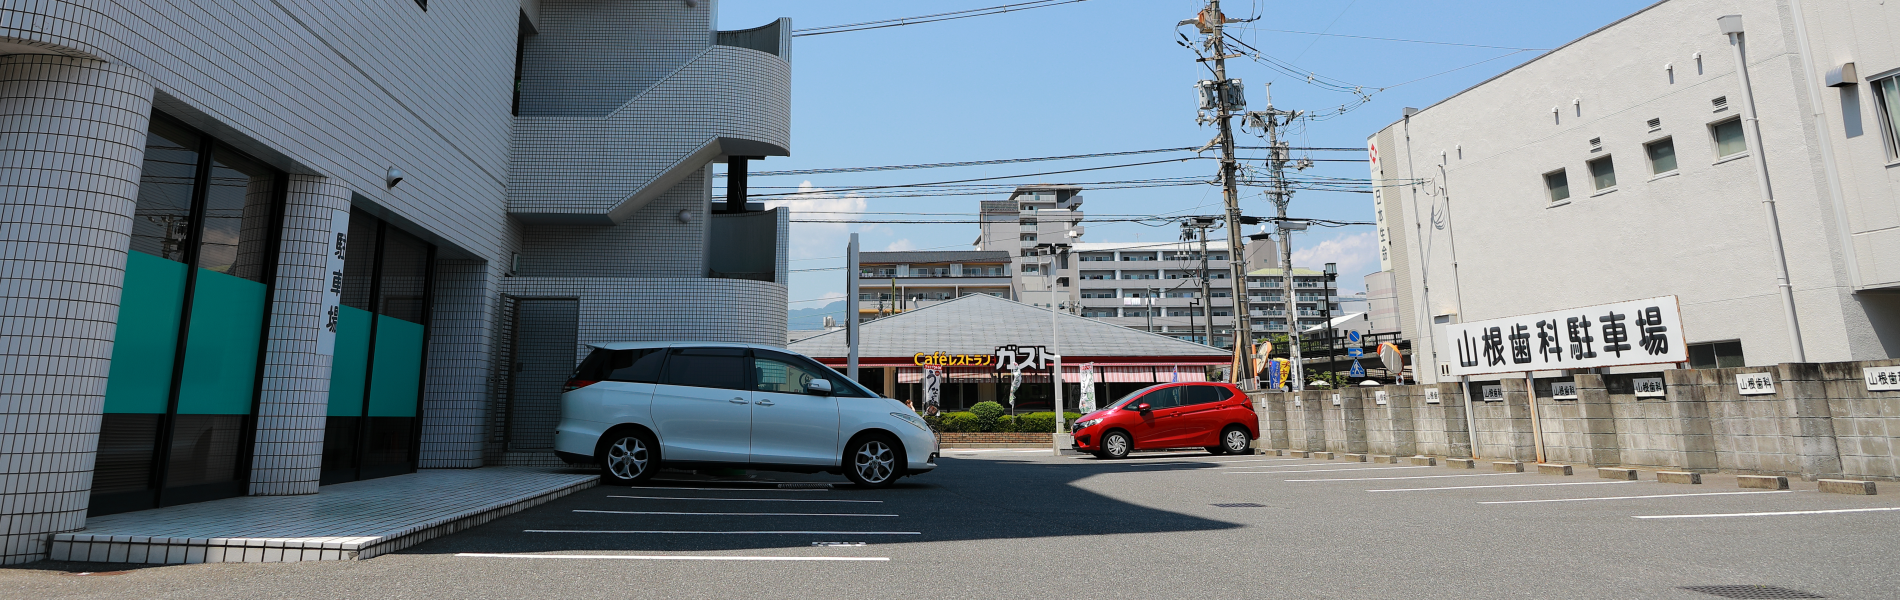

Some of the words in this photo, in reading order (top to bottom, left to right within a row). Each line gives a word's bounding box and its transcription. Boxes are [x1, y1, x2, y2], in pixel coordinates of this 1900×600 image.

[326, 232, 347, 334] 駐車場
[1457, 306, 1669, 368] 山根歯科駐車場
[995, 345, 1056, 371] ガスト
[1553, 385, 1575, 396] 山根歯科
[1635, 382, 1662, 393] 山根歯科
[1740, 376, 1772, 390] 山根歯科
